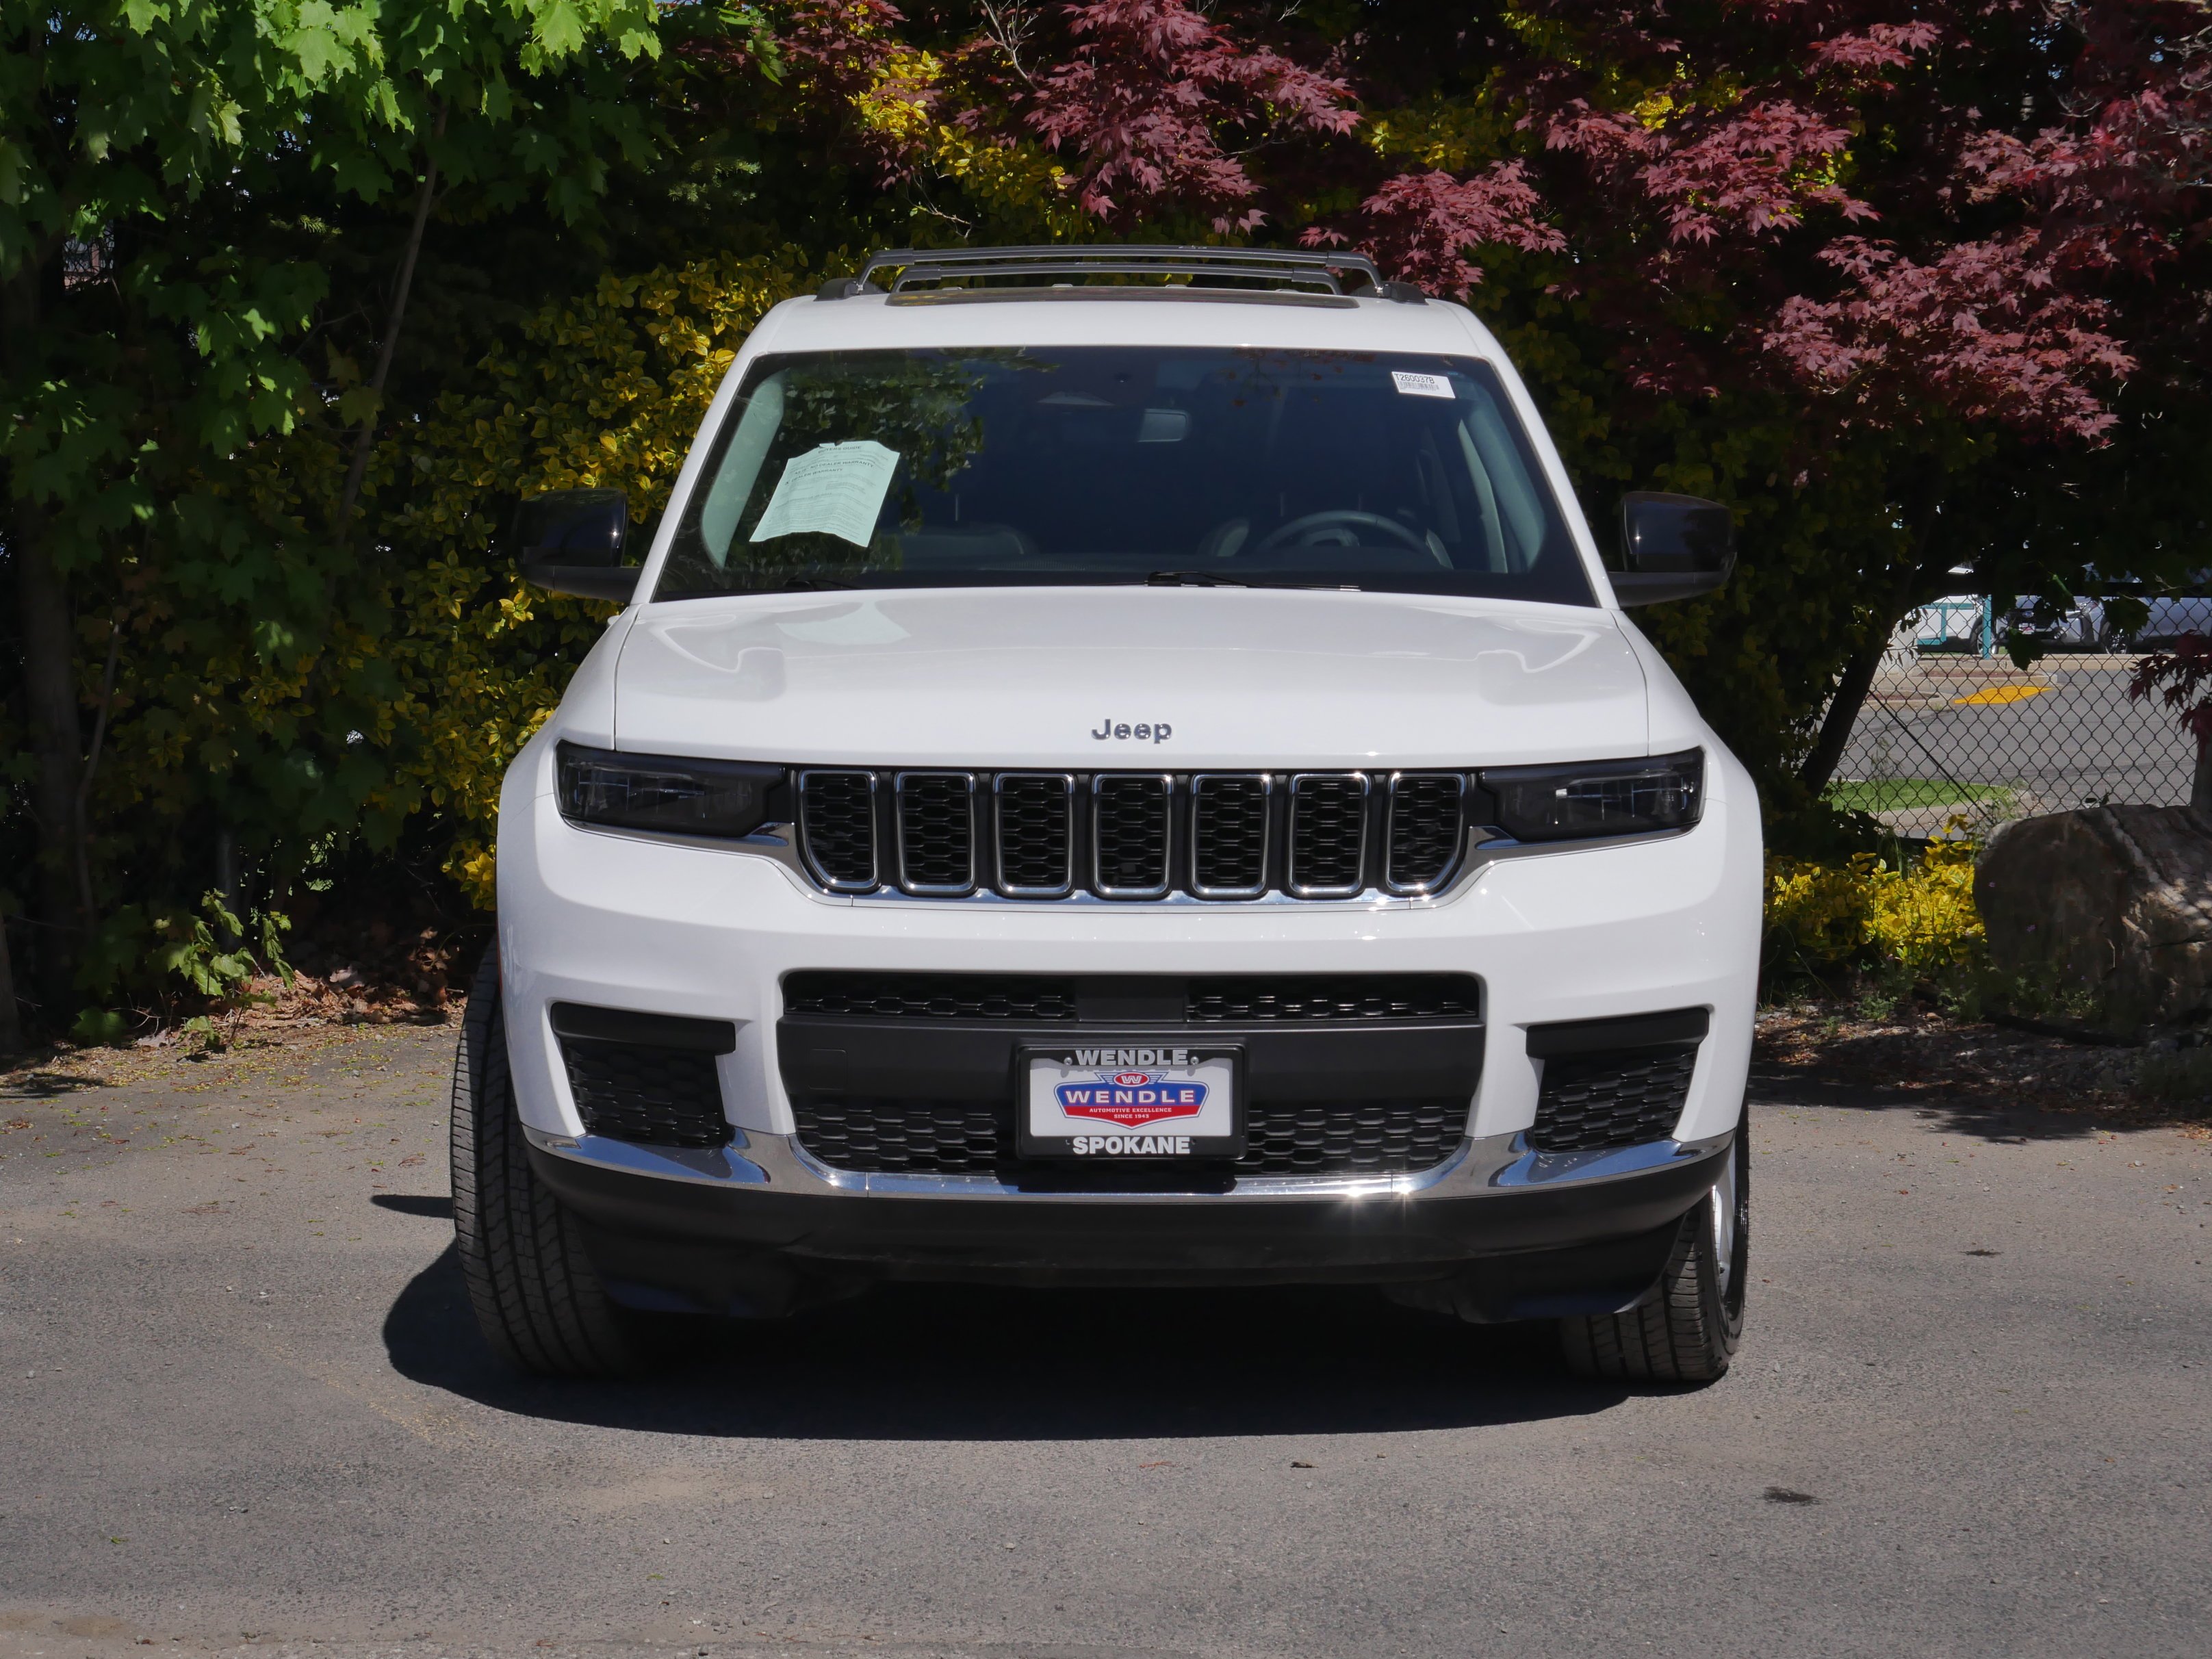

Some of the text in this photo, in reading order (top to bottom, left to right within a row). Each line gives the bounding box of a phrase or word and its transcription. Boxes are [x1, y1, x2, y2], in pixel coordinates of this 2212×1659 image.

[1092, 719, 1172, 744] Jeep
[1076, 1050, 1188, 1066] WENDLE
[1066, 1090, 1195, 1103] WENDLE
[1072, 1137, 1190, 1155] SPOKANE
